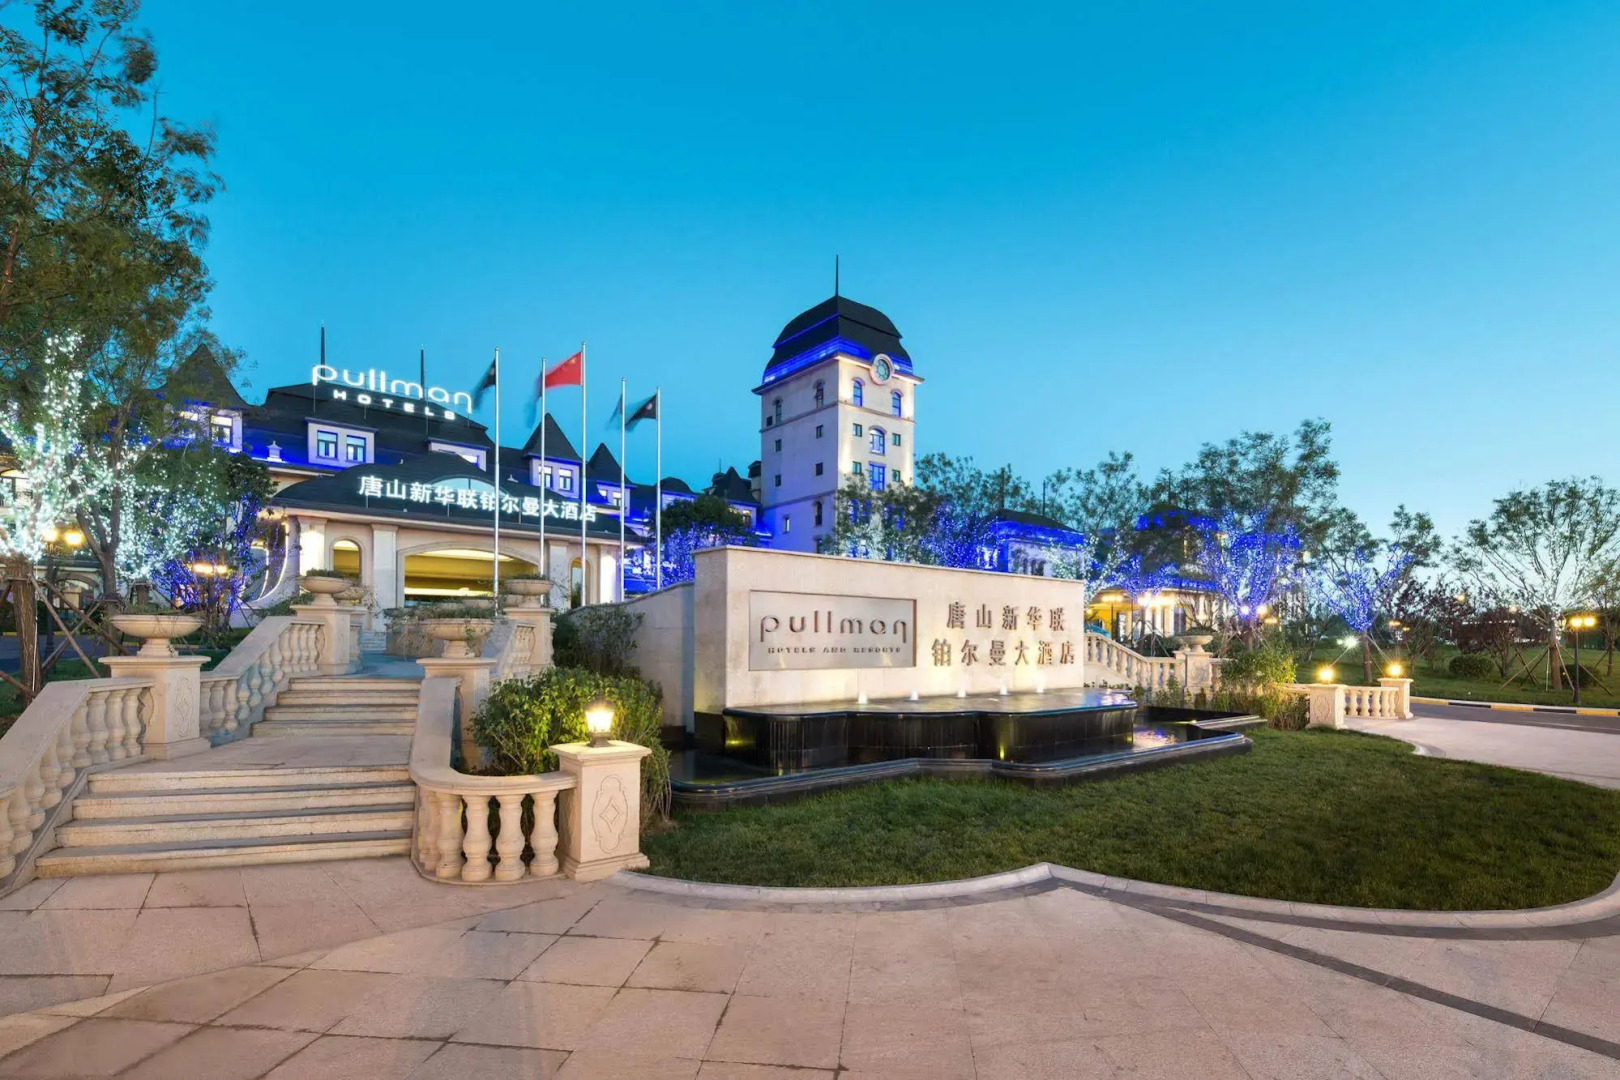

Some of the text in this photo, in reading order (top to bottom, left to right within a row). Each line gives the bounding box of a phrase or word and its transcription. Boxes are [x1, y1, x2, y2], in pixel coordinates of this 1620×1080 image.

[312, 364, 472, 414] pullman
[333, 389, 456, 420] HOTELS
[760, 610, 907, 643] pullman
[946, 601, 1065, 632] 唐山新华联
[931, 638, 1075, 667] 铂尔曼大酒店
